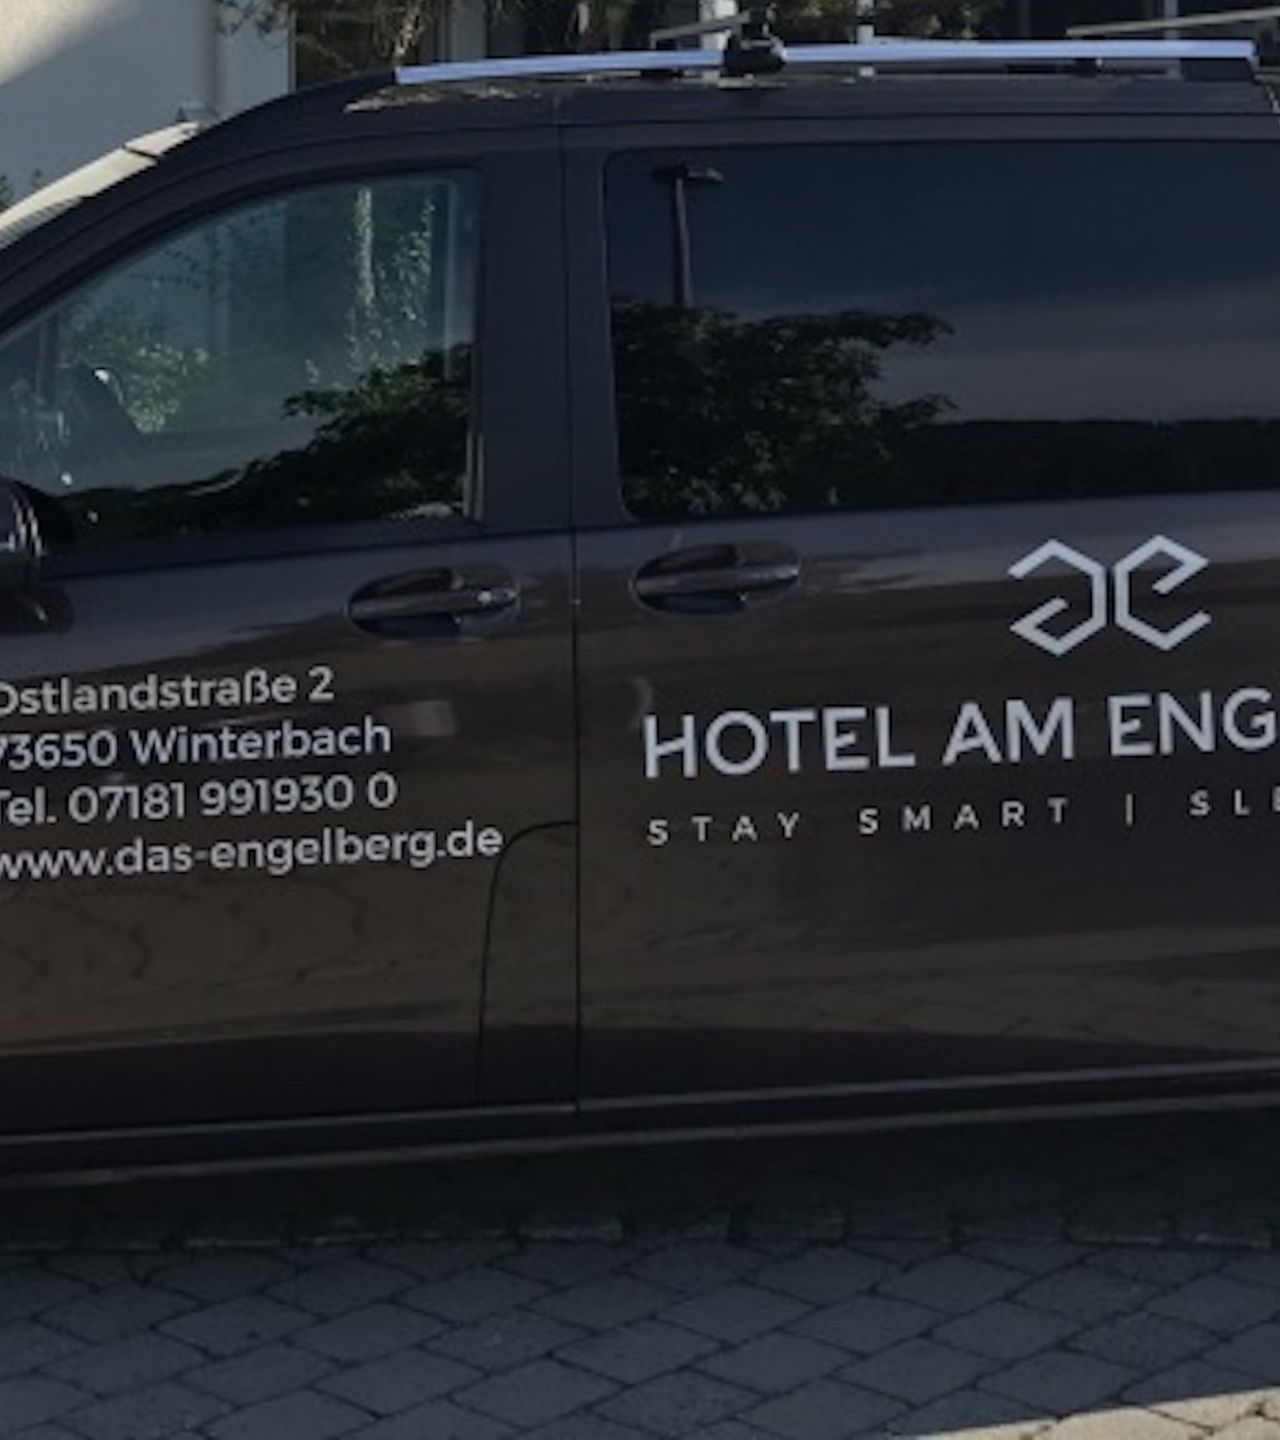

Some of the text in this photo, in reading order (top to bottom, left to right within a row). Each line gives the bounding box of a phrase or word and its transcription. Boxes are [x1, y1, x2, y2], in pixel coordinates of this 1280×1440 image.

[307, 664, 336, 704] 2
[128, 714, 393, 766] Winterbach
[642, 705, 917, 780] HOTEL
[941, 696, 1076, 767] AM
[67, 781, 186, 825] 07181
[199, 773, 357, 818] 991930
[365, 770, 400, 810] 0
[646, 810, 801, 847] STAY
[858, 796, 1068, 836] SMART
